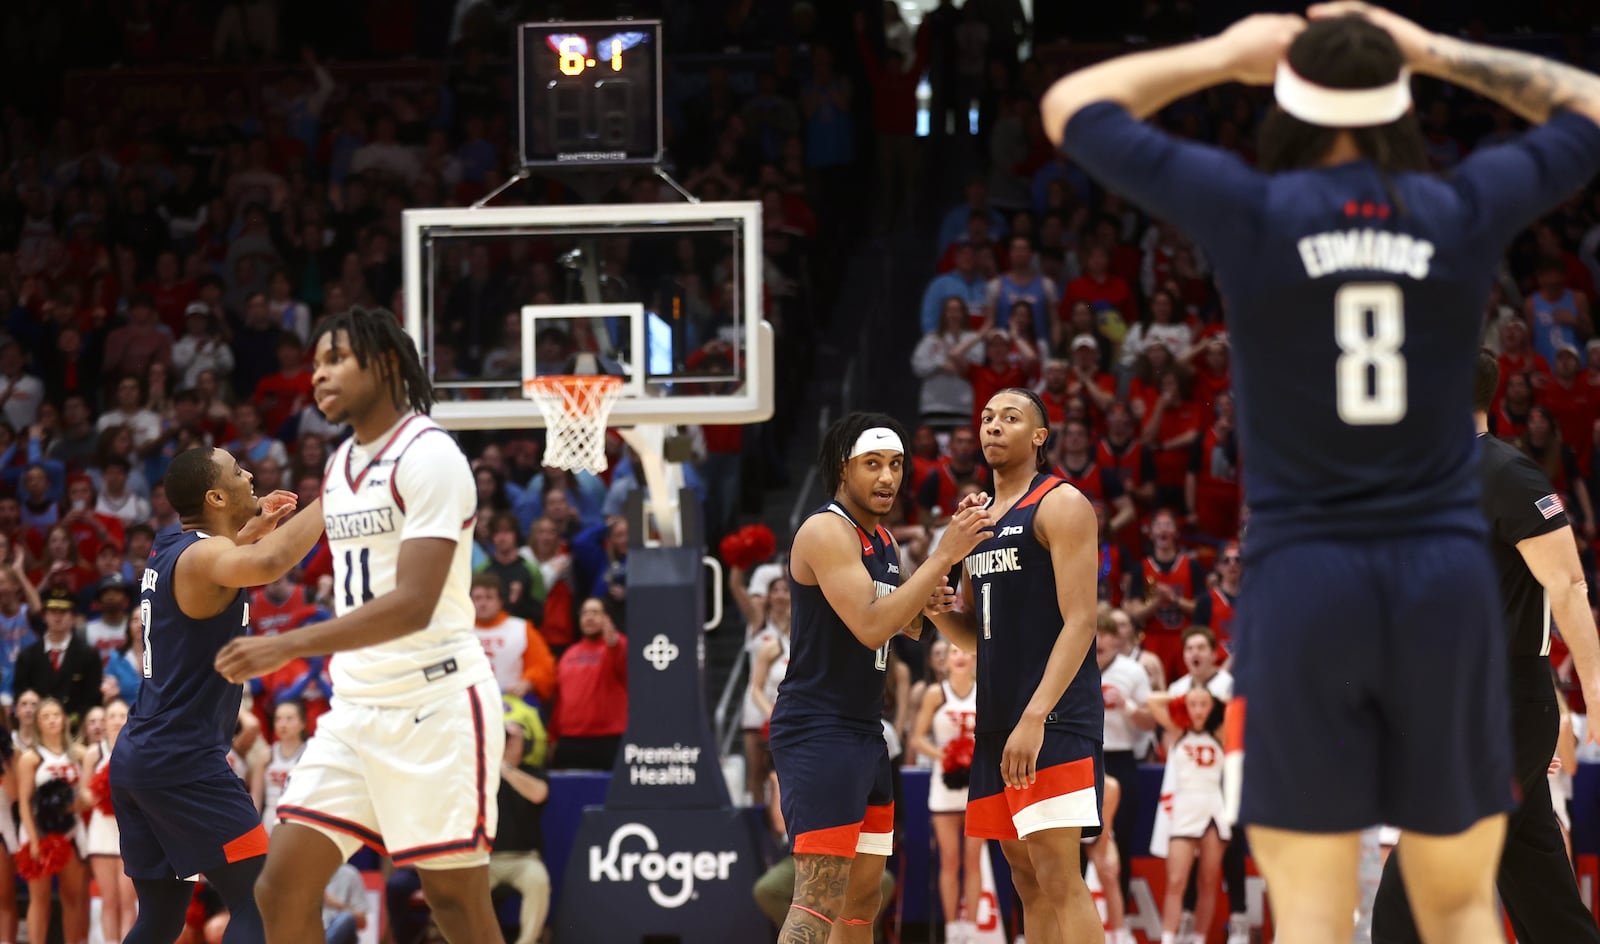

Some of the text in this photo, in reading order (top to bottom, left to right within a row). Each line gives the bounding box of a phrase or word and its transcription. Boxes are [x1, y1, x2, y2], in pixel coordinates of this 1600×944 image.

[1297, 228, 1435, 280] EDWARDS
[1334, 282, 1408, 426] 8
[344, 547, 374, 607] 11
[981, 583, 991, 640] 1
[624, 742, 701, 764] Premier
[630, 765, 696, 785] Health
[589, 822, 738, 908] Kroger
